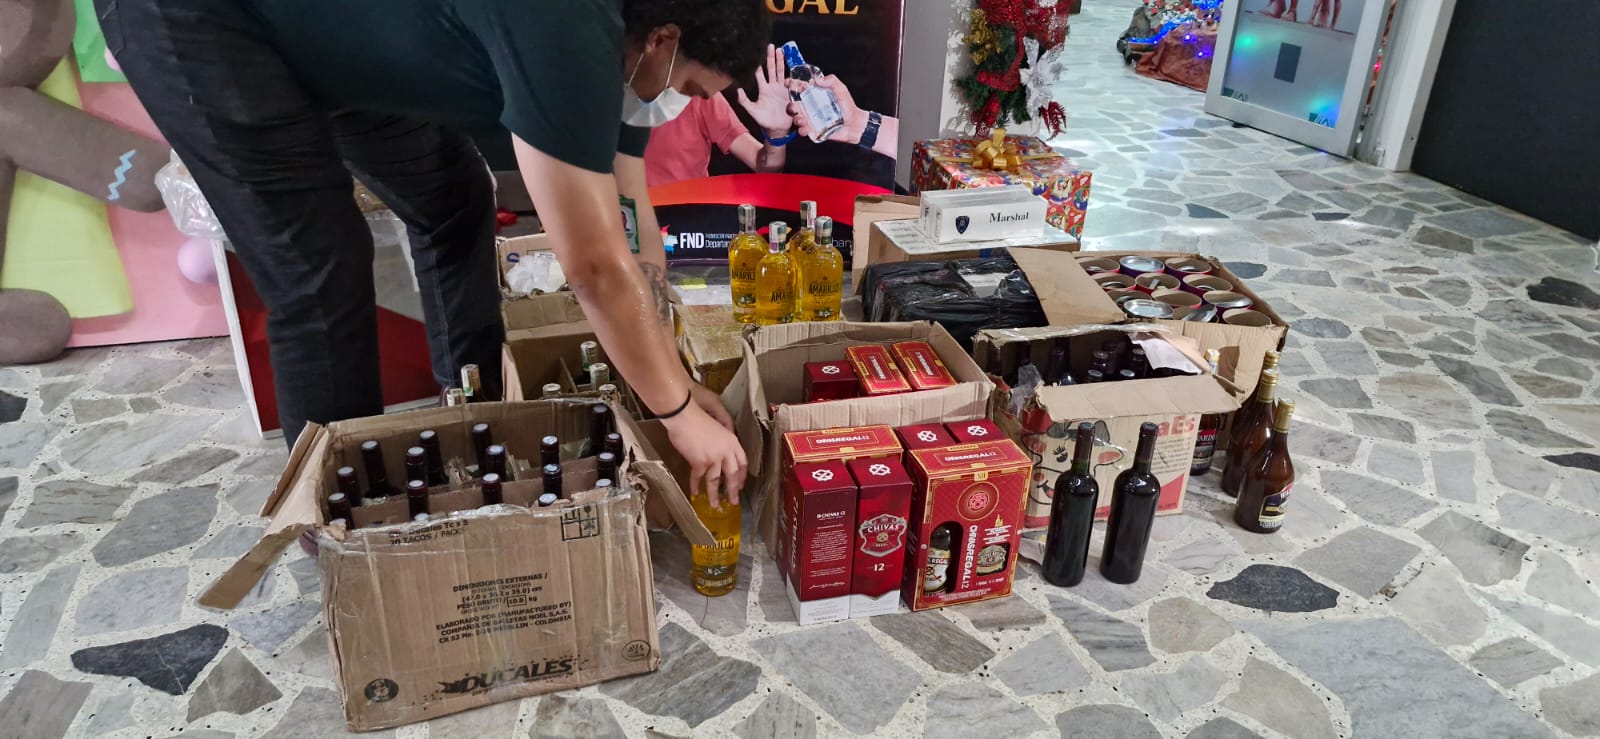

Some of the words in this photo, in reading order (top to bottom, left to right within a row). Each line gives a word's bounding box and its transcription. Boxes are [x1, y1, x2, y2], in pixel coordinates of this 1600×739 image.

[989, 212, 1029, 223] Marshal
[680, 232, 705, 249] FND
[867, 523, 899, 533] CHIVAS
[402, 534, 432, 544] TACOS
[874, 563, 885, 572] 12
[505, 573, 543, 585] EXTERNAS
[457, 601, 475, 611] PESO
[436, 616, 480, 631] ELABORADO
[560, 600, 572, 610] BY)
[530, 612, 547, 621] NOEL
[535, 614, 572, 627] COLOMBIA
[458, 658, 575, 691] DUCALES
